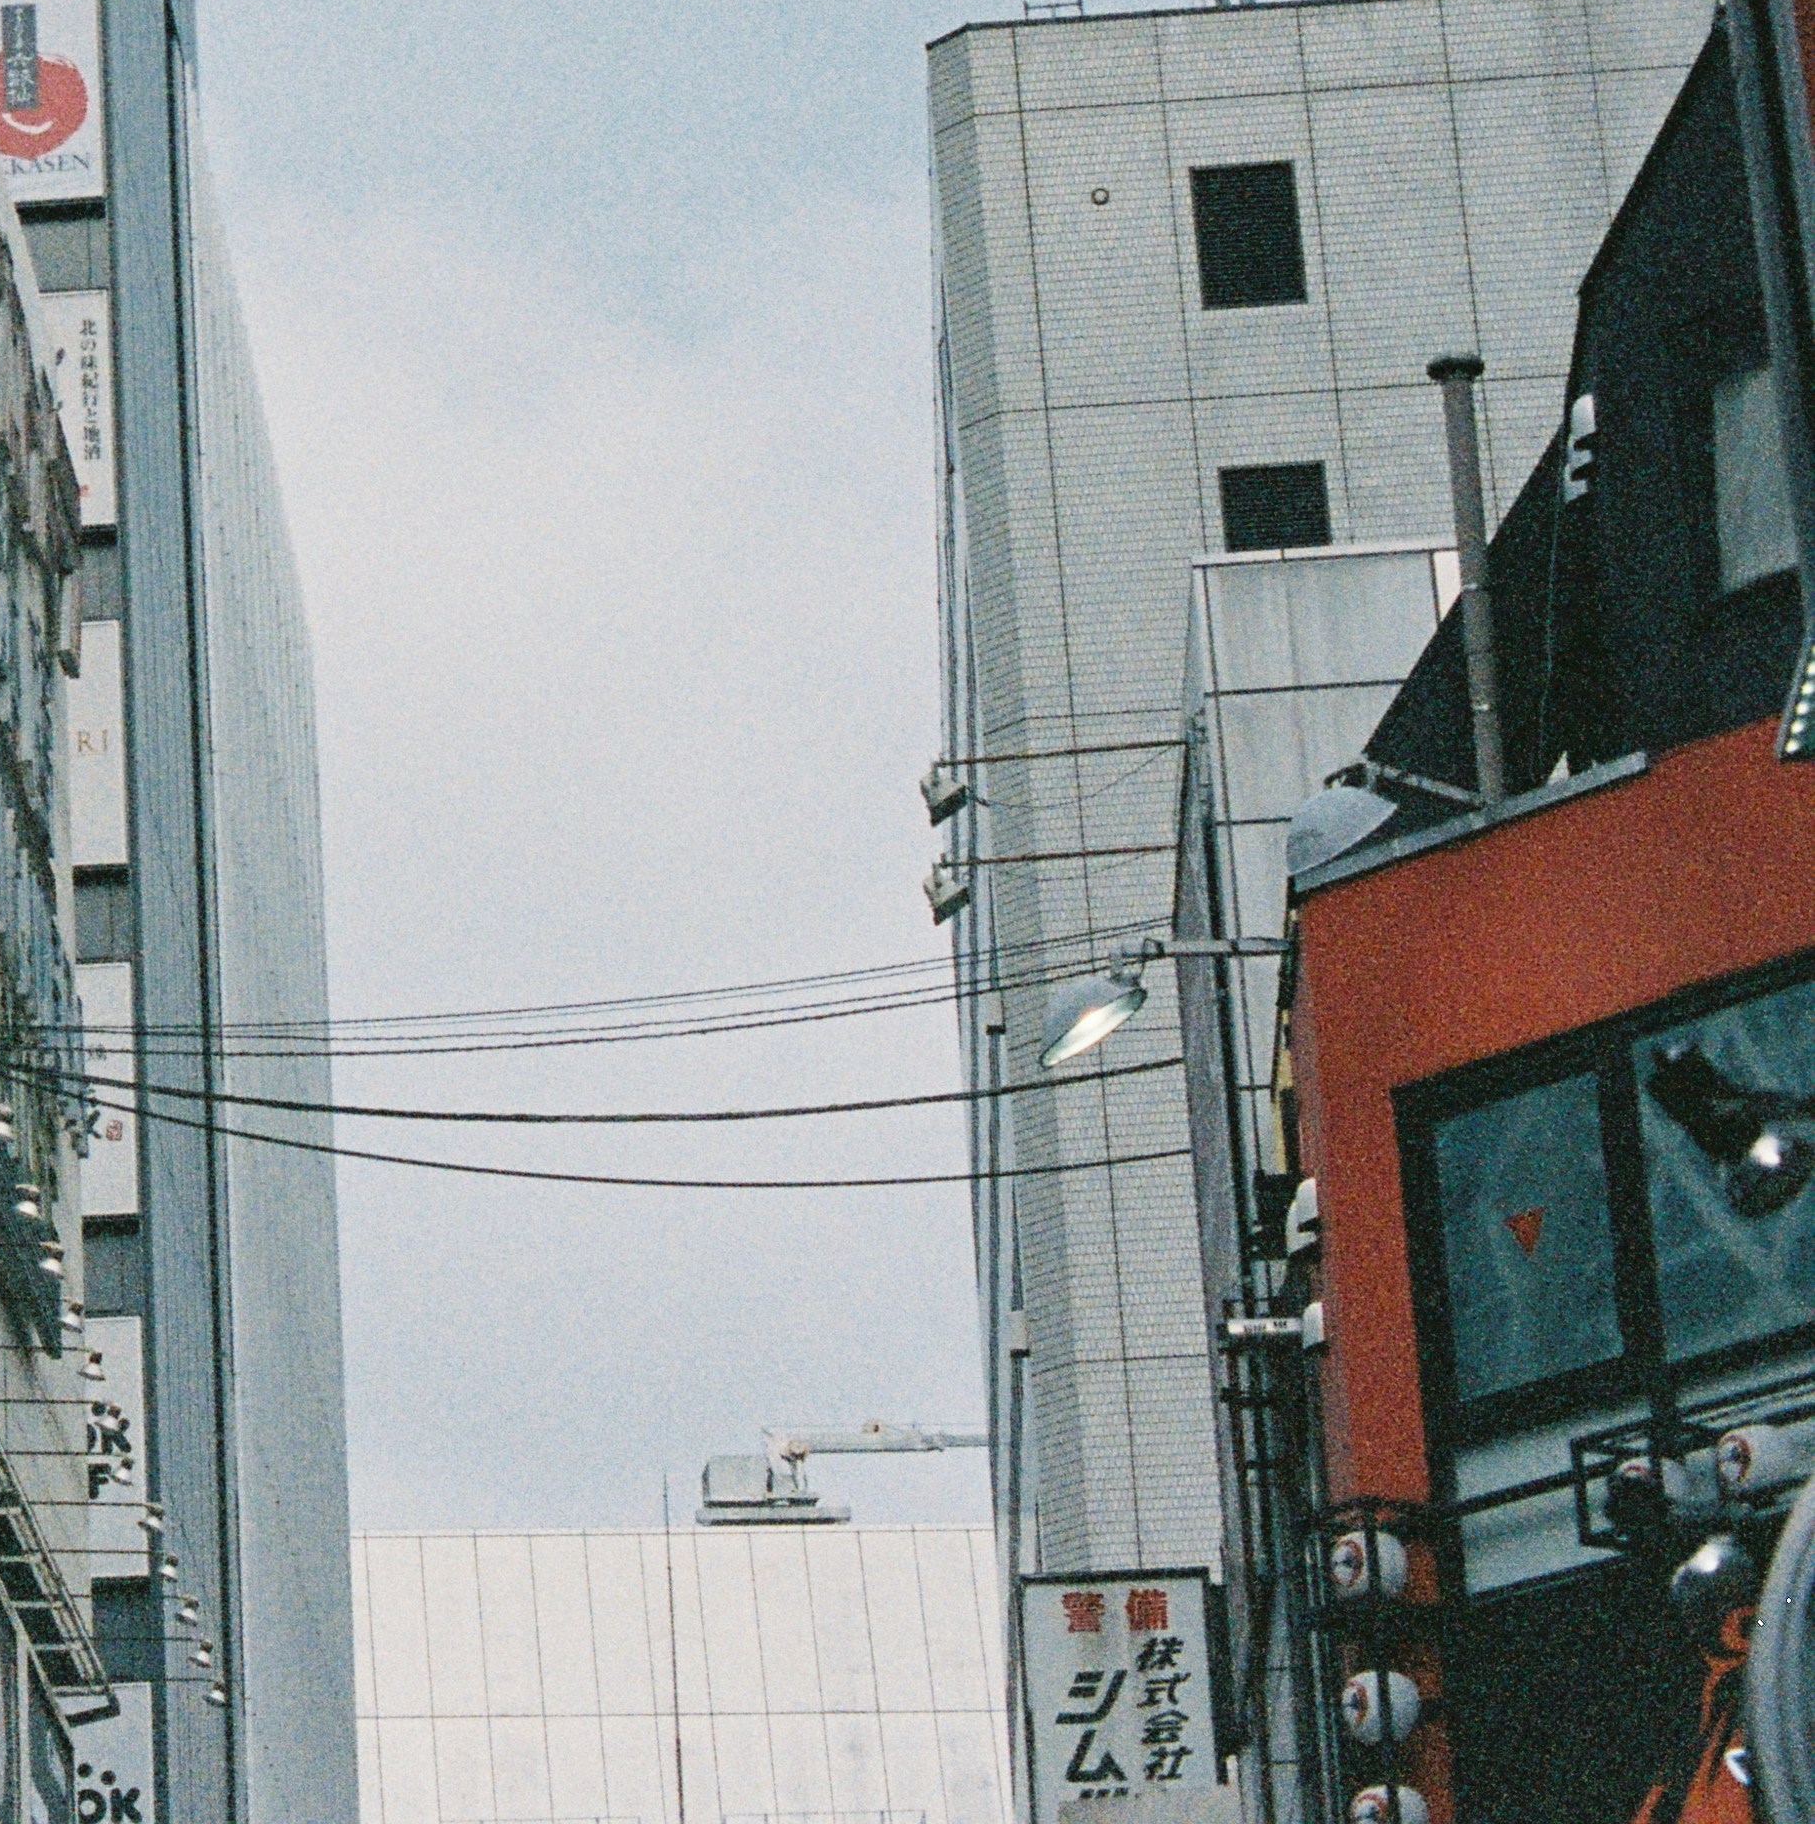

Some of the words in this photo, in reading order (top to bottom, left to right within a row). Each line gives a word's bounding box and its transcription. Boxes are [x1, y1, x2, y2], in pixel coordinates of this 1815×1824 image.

[3, 152, 90, 175] KASEN
[1061, 1587, 1170, 1633] 警備
[1135, 1635, 1195, 1782] 株式会社
